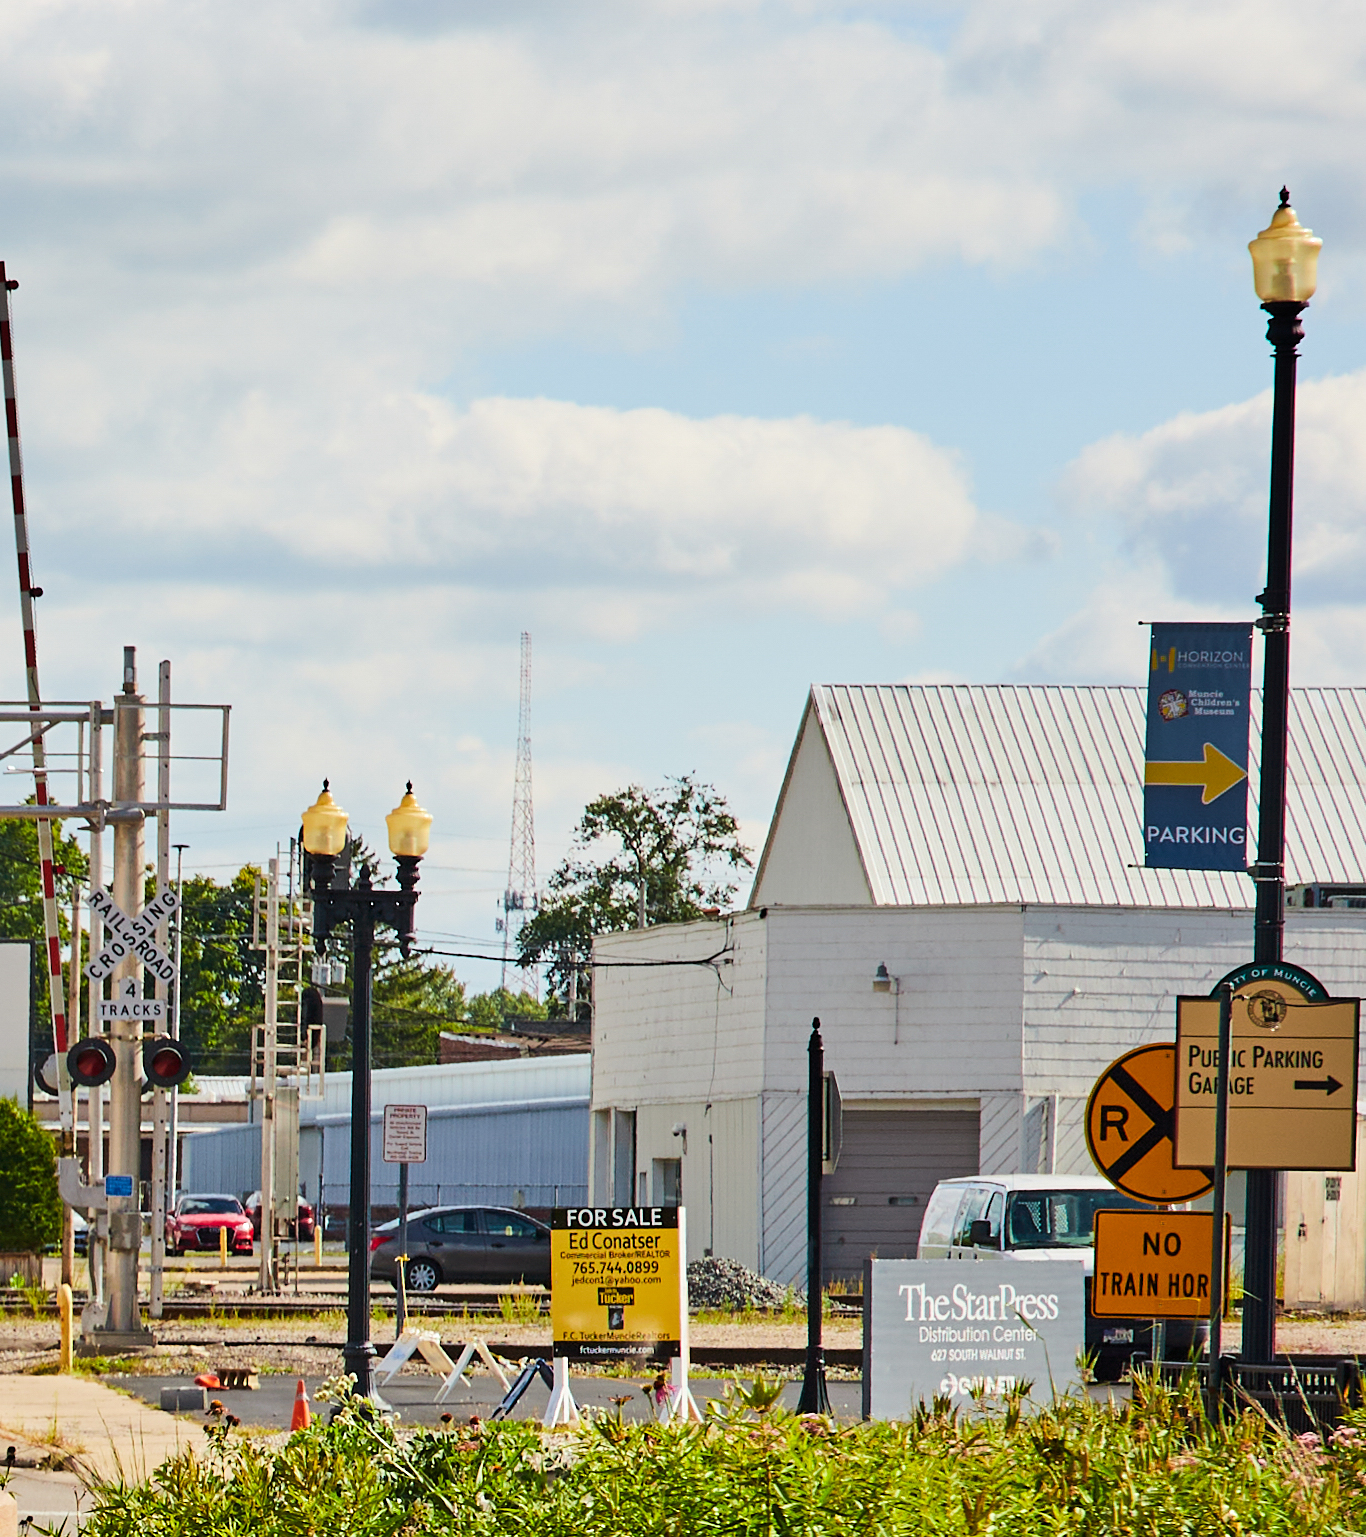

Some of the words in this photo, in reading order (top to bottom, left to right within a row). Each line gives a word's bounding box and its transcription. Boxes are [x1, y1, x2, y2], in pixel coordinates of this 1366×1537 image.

[1177, 651, 1244, 663] HORIZON
[1189, 690, 1224, 698] Muncie
[1191, 698, 1240, 707] Children's
[1194, 707, 1235, 715] Museum
[1147, 825, 1245, 845] PARKING
[89, 892, 176, 979] CROSSING
[1251, 969, 1268, 977] OF
[1273, 968, 1317, 997] MUNCIE
[125, 983, 136, 998] 4
[101, 1004, 161, 1016] TRACKS
[1189, 1045, 1246, 1067] PUBIC
[1252, 1046, 1324, 1068] PARKING
[1189, 1072, 1255, 1094] GAGE
[1100, 1105, 1129, 1141] R
[567, 1208, 607, 1227] FOR
[612, 1208, 663, 1226] SALE
[569, 1231, 589, 1250] Ed
[592, 1232, 661, 1250] Conatser
[1143, 1232, 1181, 1256] NO
[572, 1260, 659, 1274] 765.744.0899
[571, 1275, 661, 1287] jedcon1@yahoo.com
[1101, 1272, 1158, 1296] TRAIN
[1169, 1273, 1209, 1298] HOR
[599, 1292, 633, 1304] Tucker
[563, 1332, 578, 1340] F.C.
[919, 1326, 990, 1342] Distribution
[993, 1326, 1038, 1342] Center
[579, 1345, 655, 1354] fctuckermuncie.com
[931, 1349, 948, 1361] 627
[949, 1349, 978, 1361] SOUTH
[979, 1348, 1014, 1361] WALNUT
[1015, 1348, 1026, 1360] ST.
